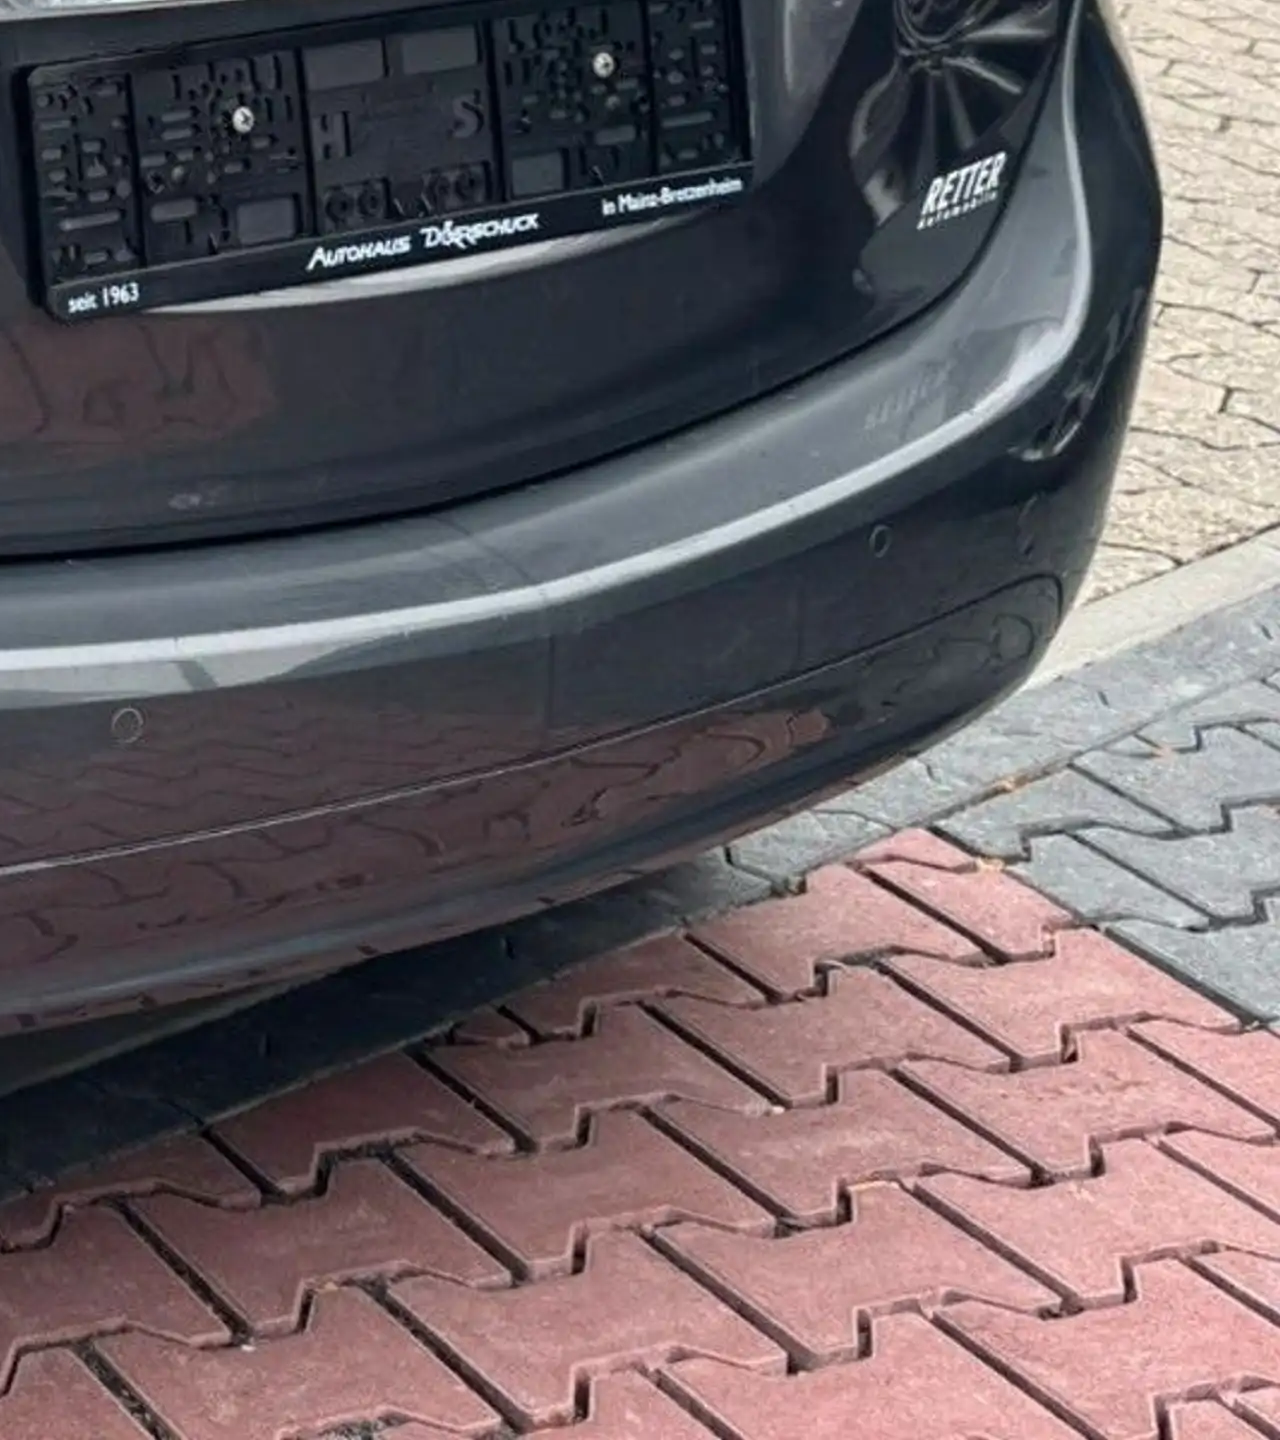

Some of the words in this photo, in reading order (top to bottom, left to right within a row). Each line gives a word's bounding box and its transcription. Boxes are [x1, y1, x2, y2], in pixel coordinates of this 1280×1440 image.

[921, 151, 1006, 215] RETTER
[602, 198, 616, 215] in
[306, 235, 412, 271] AUTOHAUS
[68, 293, 98, 314] seit
[102, 282, 139, 307] 1963
